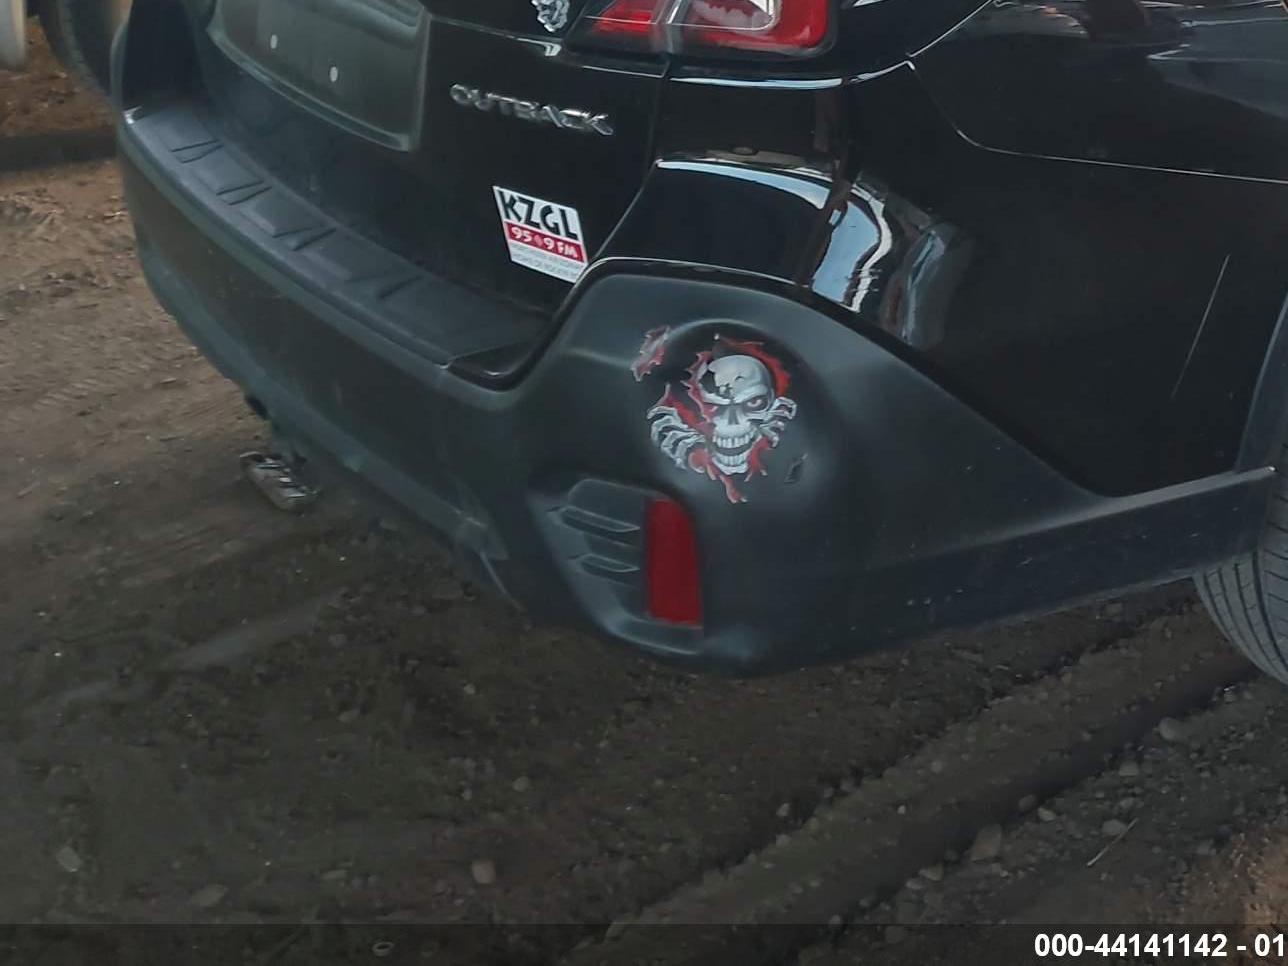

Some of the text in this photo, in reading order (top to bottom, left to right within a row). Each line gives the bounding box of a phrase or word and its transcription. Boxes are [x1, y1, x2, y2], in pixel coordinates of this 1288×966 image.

[450, 84, 614, 135] OUTBACK
[498, 189, 580, 241] KZGL
[556, 241, 579, 259] FM
